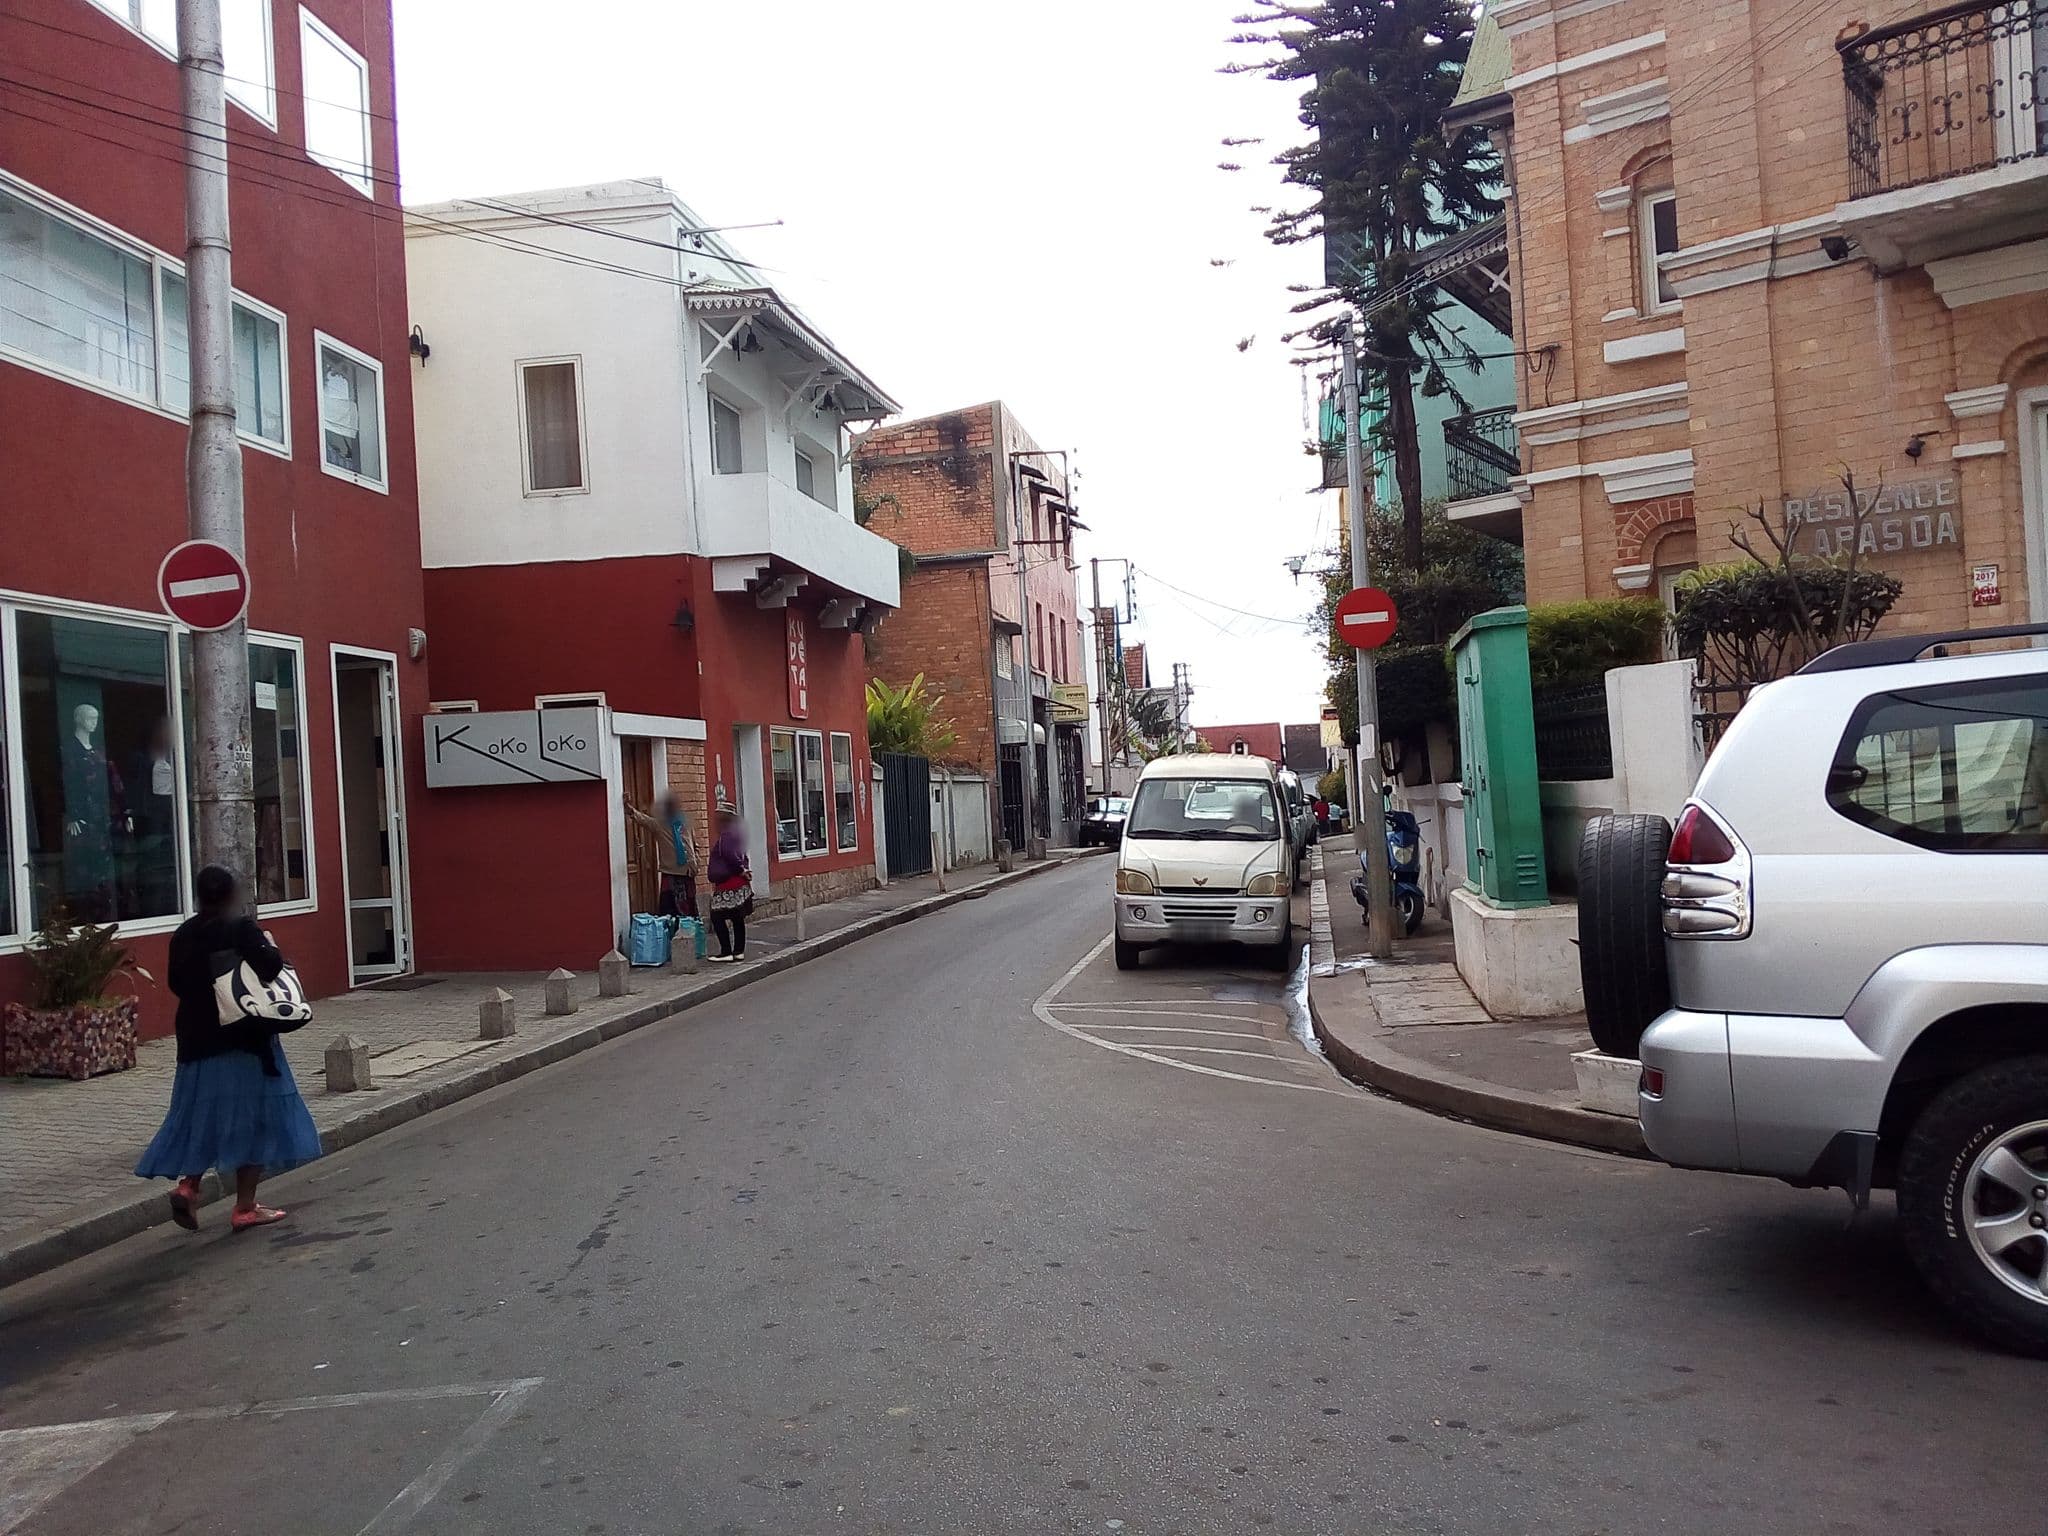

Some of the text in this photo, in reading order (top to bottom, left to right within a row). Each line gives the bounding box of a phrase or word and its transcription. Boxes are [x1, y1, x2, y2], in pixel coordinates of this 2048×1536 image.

[1814, 512, 1957, 557] APASOA
[1975, 571, 1995, 581] 2017
[788, 618, 804, 640] KU
